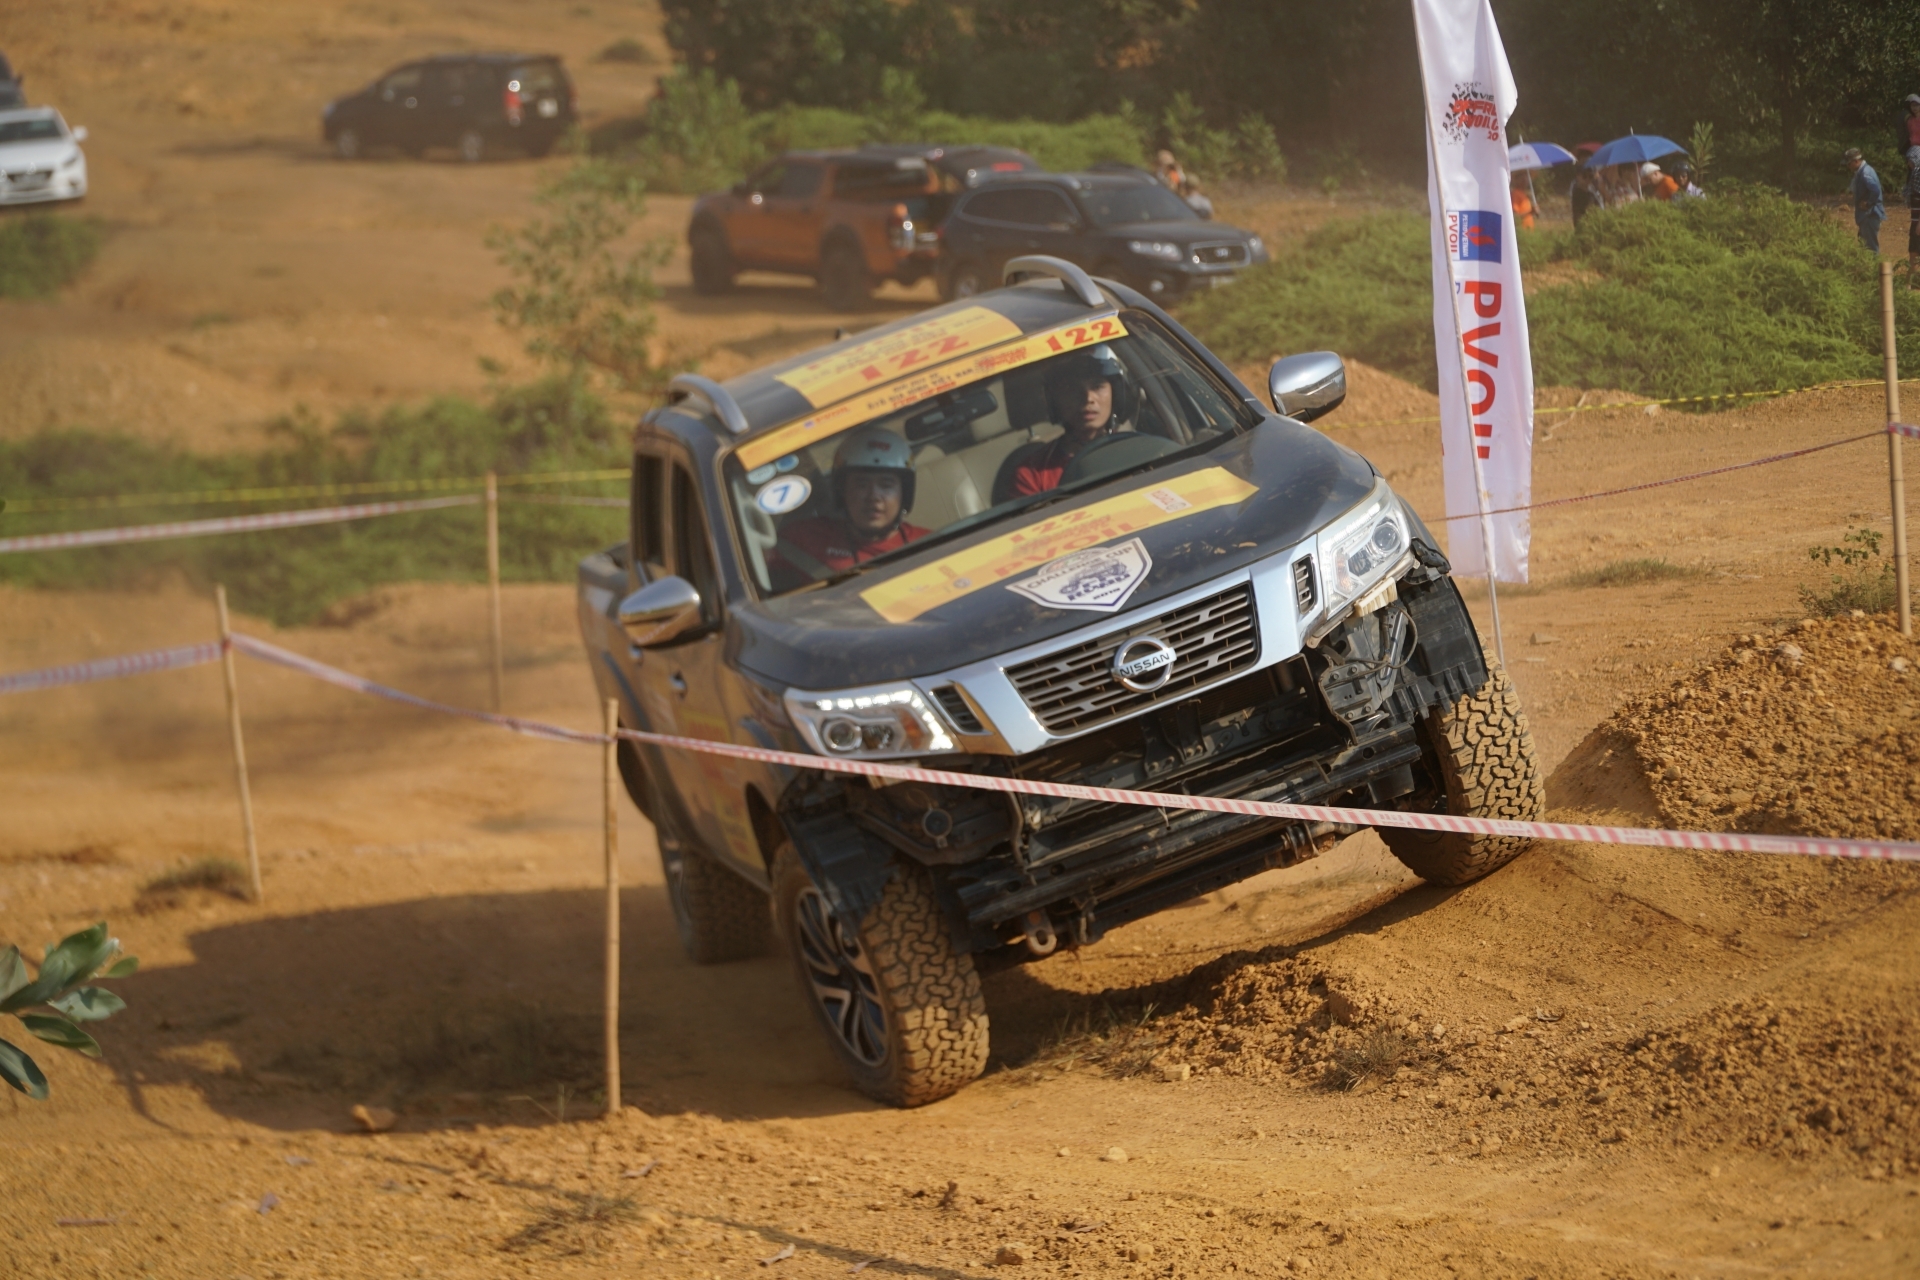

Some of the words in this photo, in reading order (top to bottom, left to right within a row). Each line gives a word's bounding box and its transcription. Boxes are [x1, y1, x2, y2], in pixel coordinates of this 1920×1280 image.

[1046, 321, 1120, 352] 122
[860, 335, 970, 381] 122
[773, 484, 791, 505] 7
[1010, 511, 1094, 544] 122
[994, 522, 1150, 577] PVOIL
[1027, 556, 1102, 590] CHALLENGE
[1105, 546, 1133, 559] CUP
[1119, 652, 1170, 677] NISSAN
